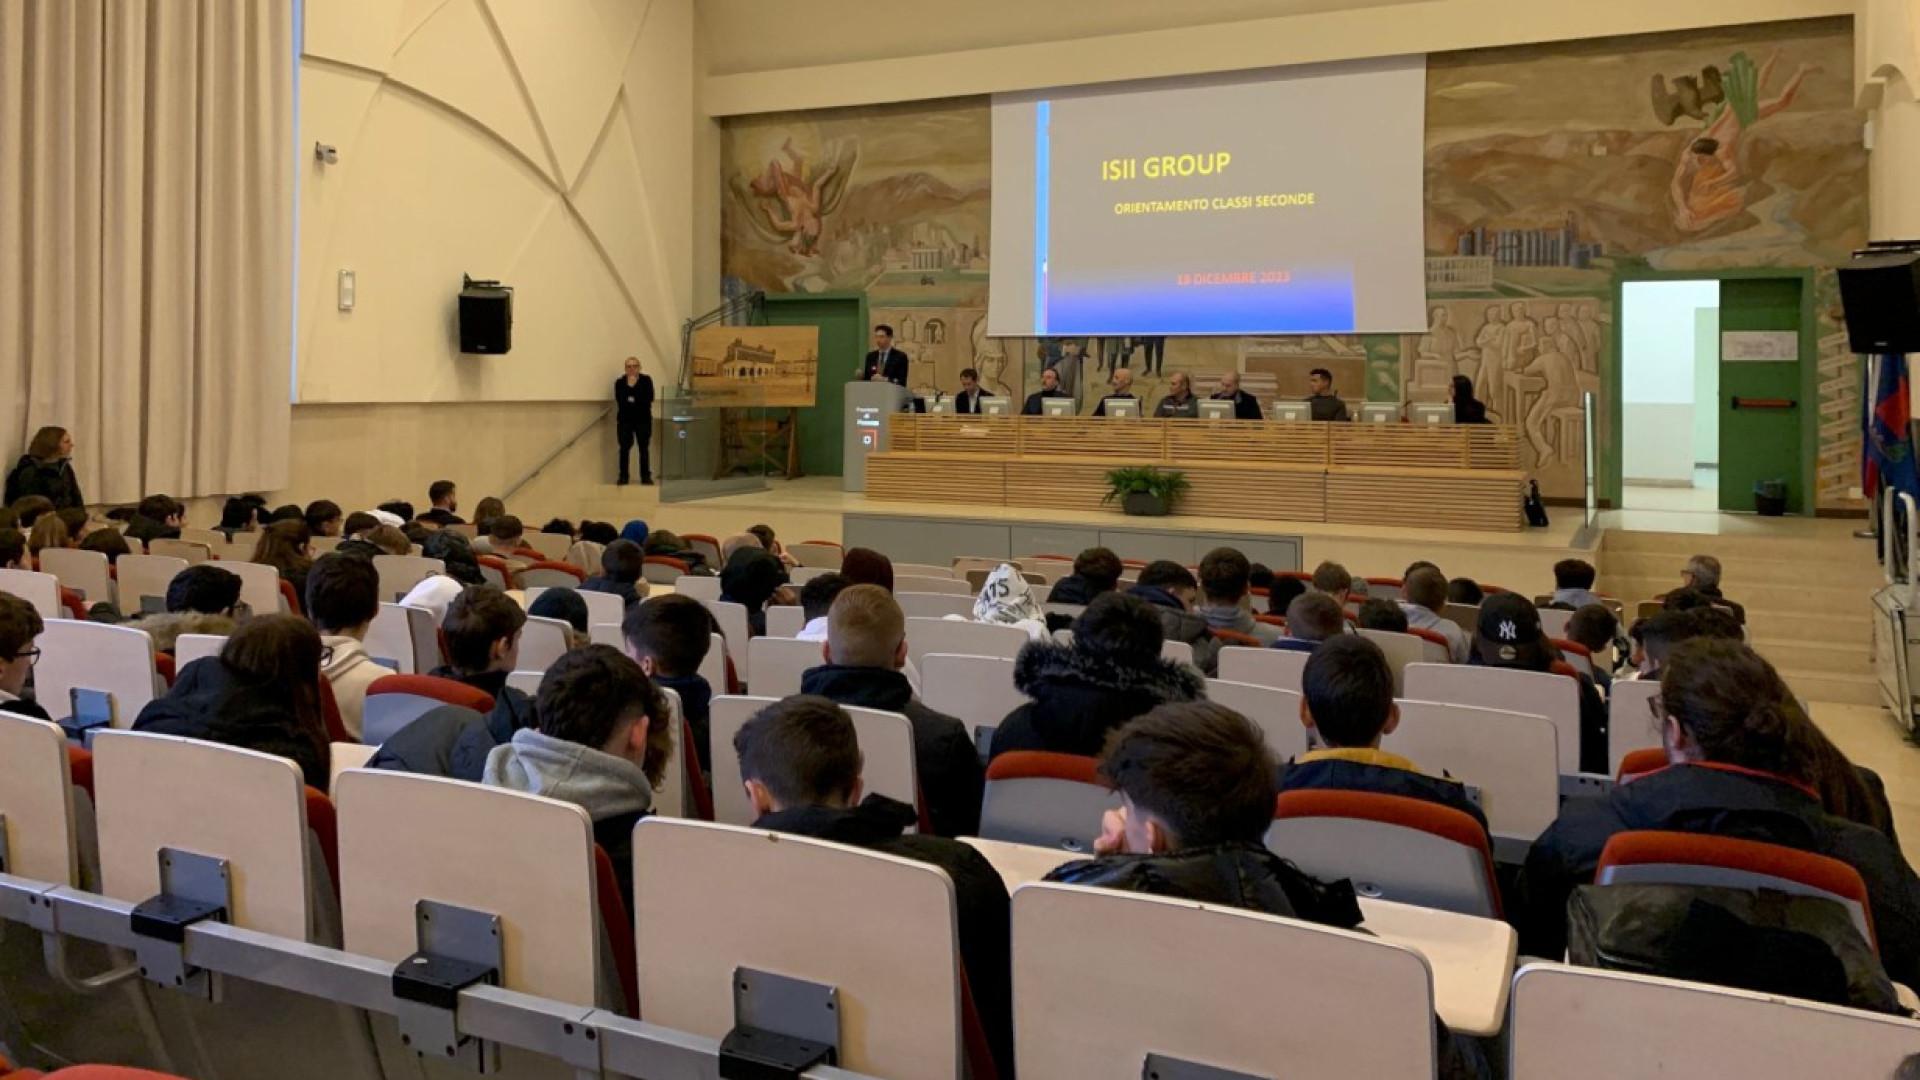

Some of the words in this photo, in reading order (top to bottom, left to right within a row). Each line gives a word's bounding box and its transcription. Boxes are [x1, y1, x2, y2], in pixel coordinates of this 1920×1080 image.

[1102, 158, 1136, 181] ISII
[1143, 152, 1231, 178] GROUP
[1114, 198, 1209, 214] ORIENTAMENTO
[1212, 197, 1252, 210] CLASSI
[1255, 193, 1315, 208] SECONDE
[1194, 271, 1257, 285] DICEMBRE
[1499, 620, 1516, 640] NY
